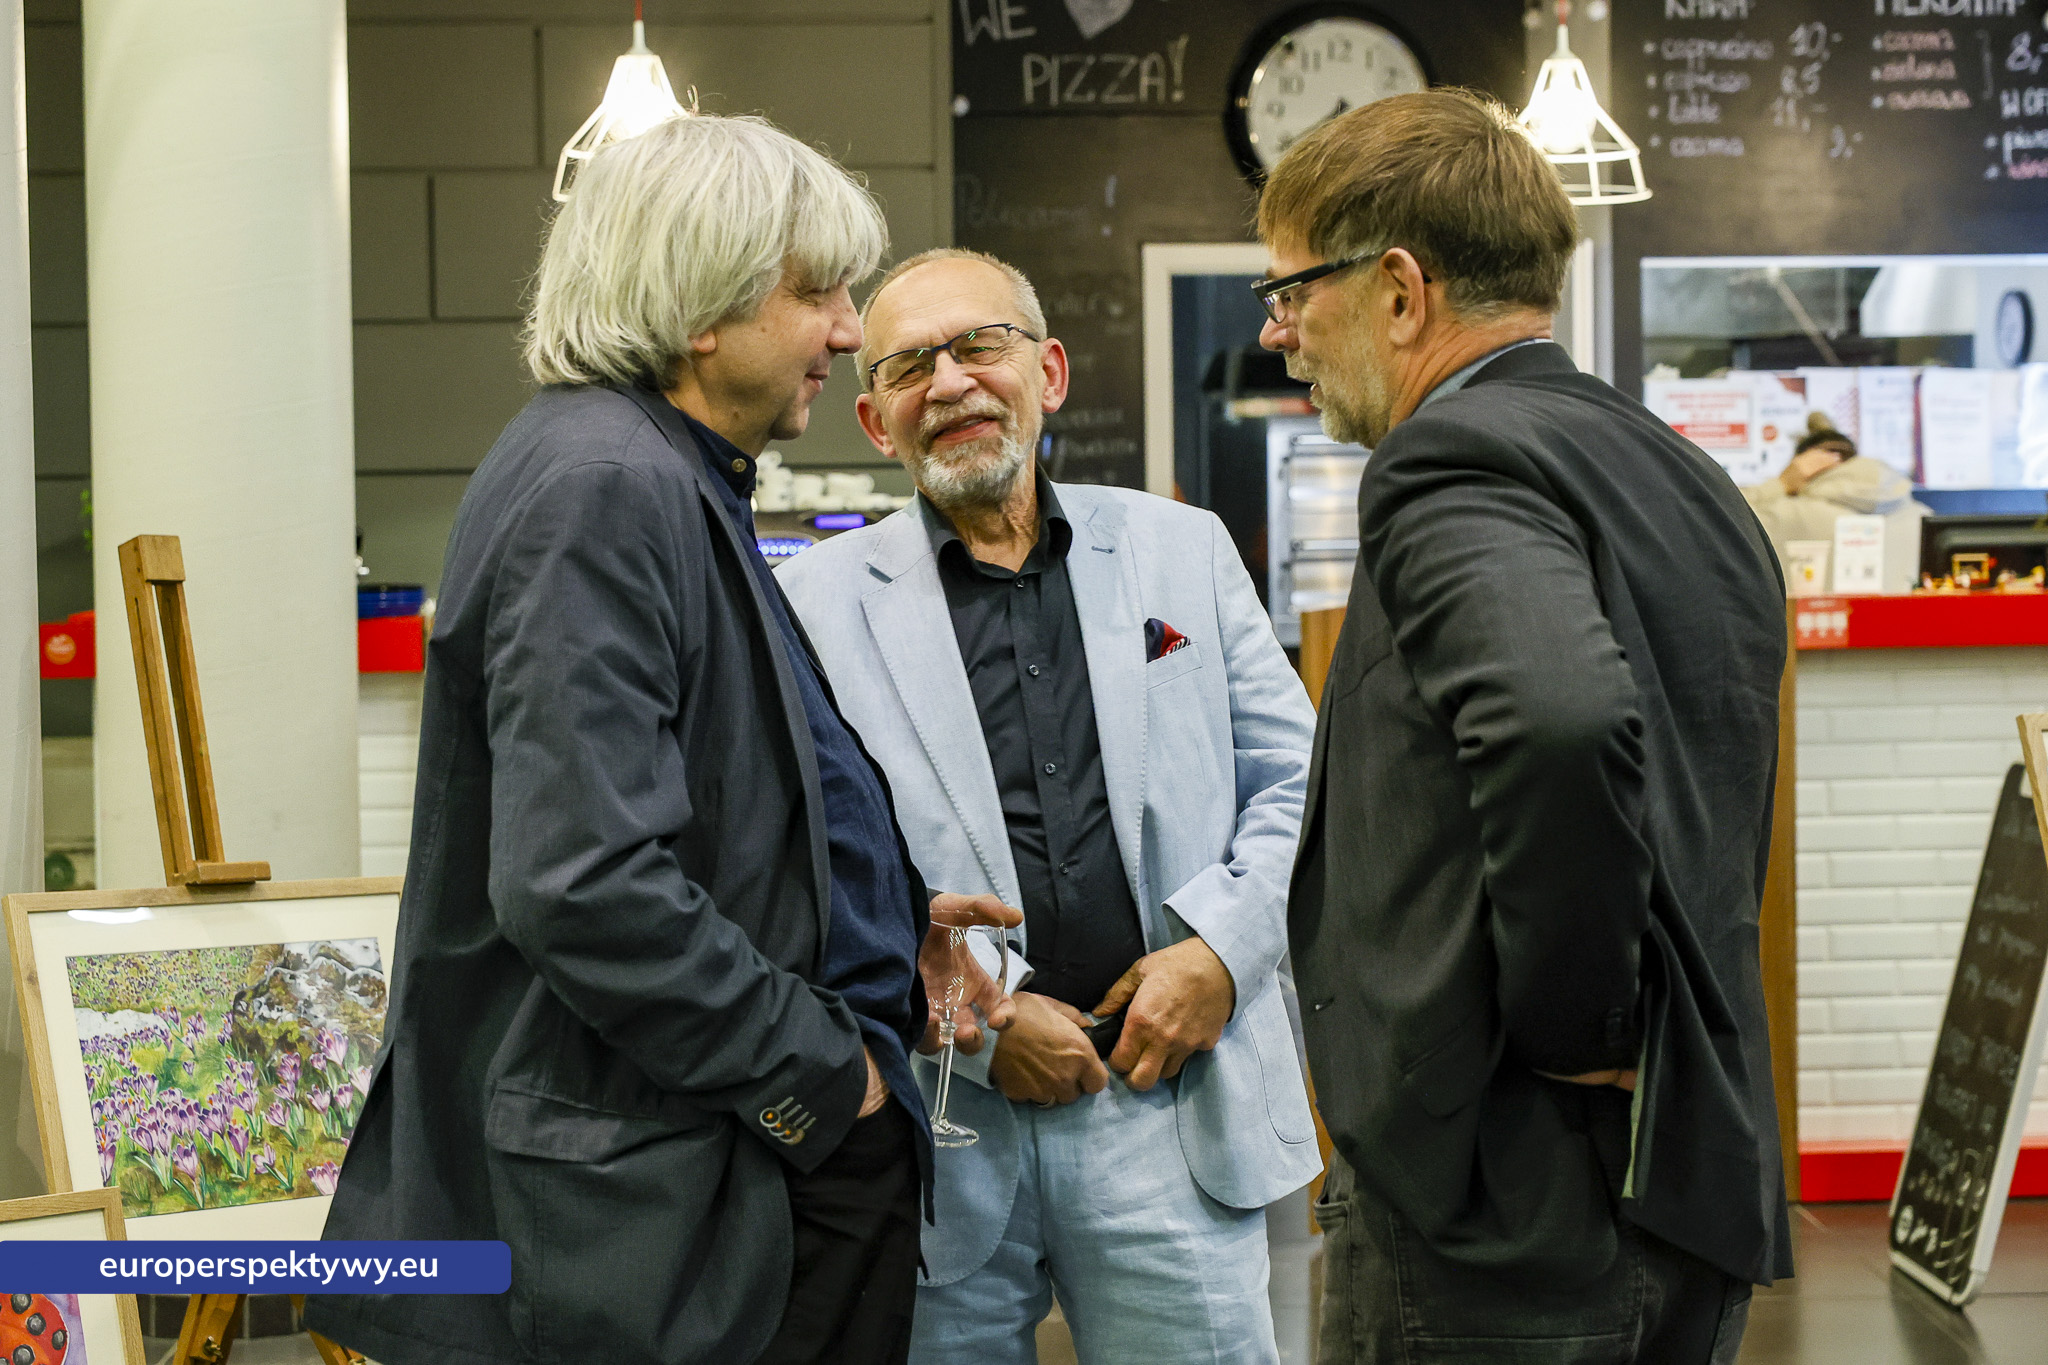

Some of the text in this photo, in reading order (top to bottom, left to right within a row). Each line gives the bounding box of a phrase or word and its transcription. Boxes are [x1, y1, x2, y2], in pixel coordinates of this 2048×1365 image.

[958, 0, 1037, 46] WE
[1300, 49, 1323, 73] 11
[1326, 32, 1354, 64] 12
[1022, 33, 1190, 107] PIZZA!
[1278, 75, 1306, 96] 10
